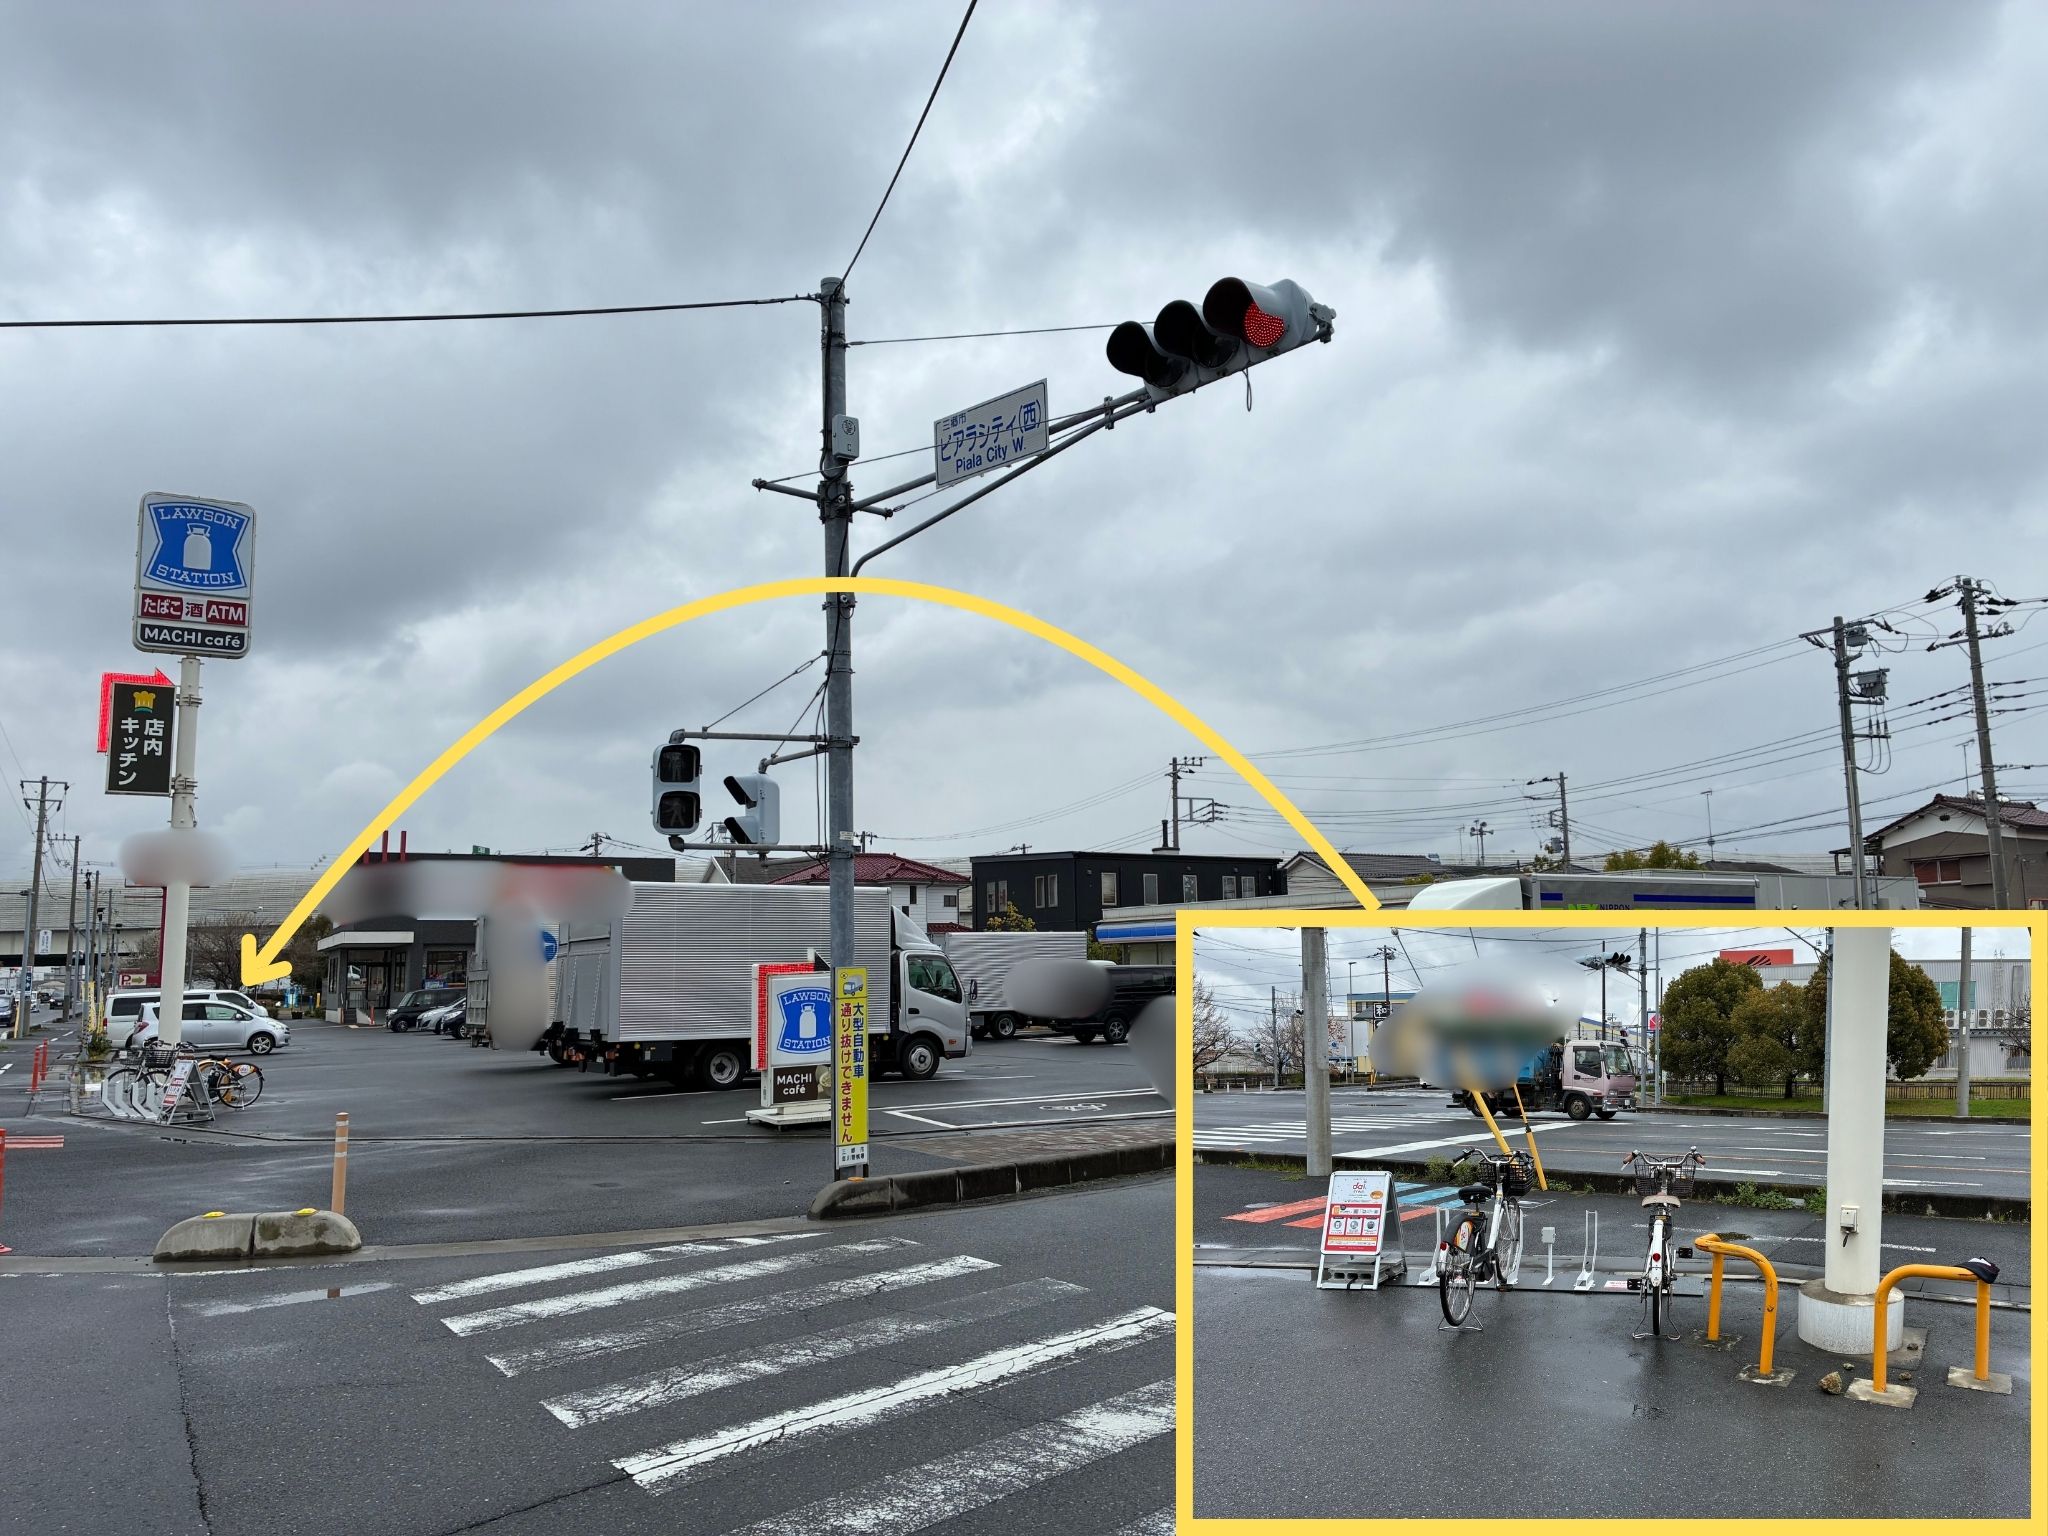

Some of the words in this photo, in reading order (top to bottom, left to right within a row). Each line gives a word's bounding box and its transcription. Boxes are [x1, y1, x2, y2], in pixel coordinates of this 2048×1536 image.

[956, 453, 983, 474] Piala
[986, 444, 1008, 463] City
[1012, 436, 1027, 453] W.
[158, 507, 241, 530] LAWSON
[156, 563, 236, 585] STATION
[143, 597, 182, 616] たばこ
[185, 602, 204, 618] 酒
[207, 604, 244, 622] ATM
[144, 627, 202, 645] MACHI
[204, 635, 241, 648] café
[143, 718, 165, 757] 店内
[117, 717, 140, 787] キッチン
[783, 991, 831, 1006] LAWSON
[783, 1035, 831, 1050] STATION
[852, 1003, 865, 1079] 大型自動車
[776, 1072, 812, 1085] MACHI
[840, 1003, 853, 1144] 通り抜けできません
[782, 1084, 806, 1096] café
